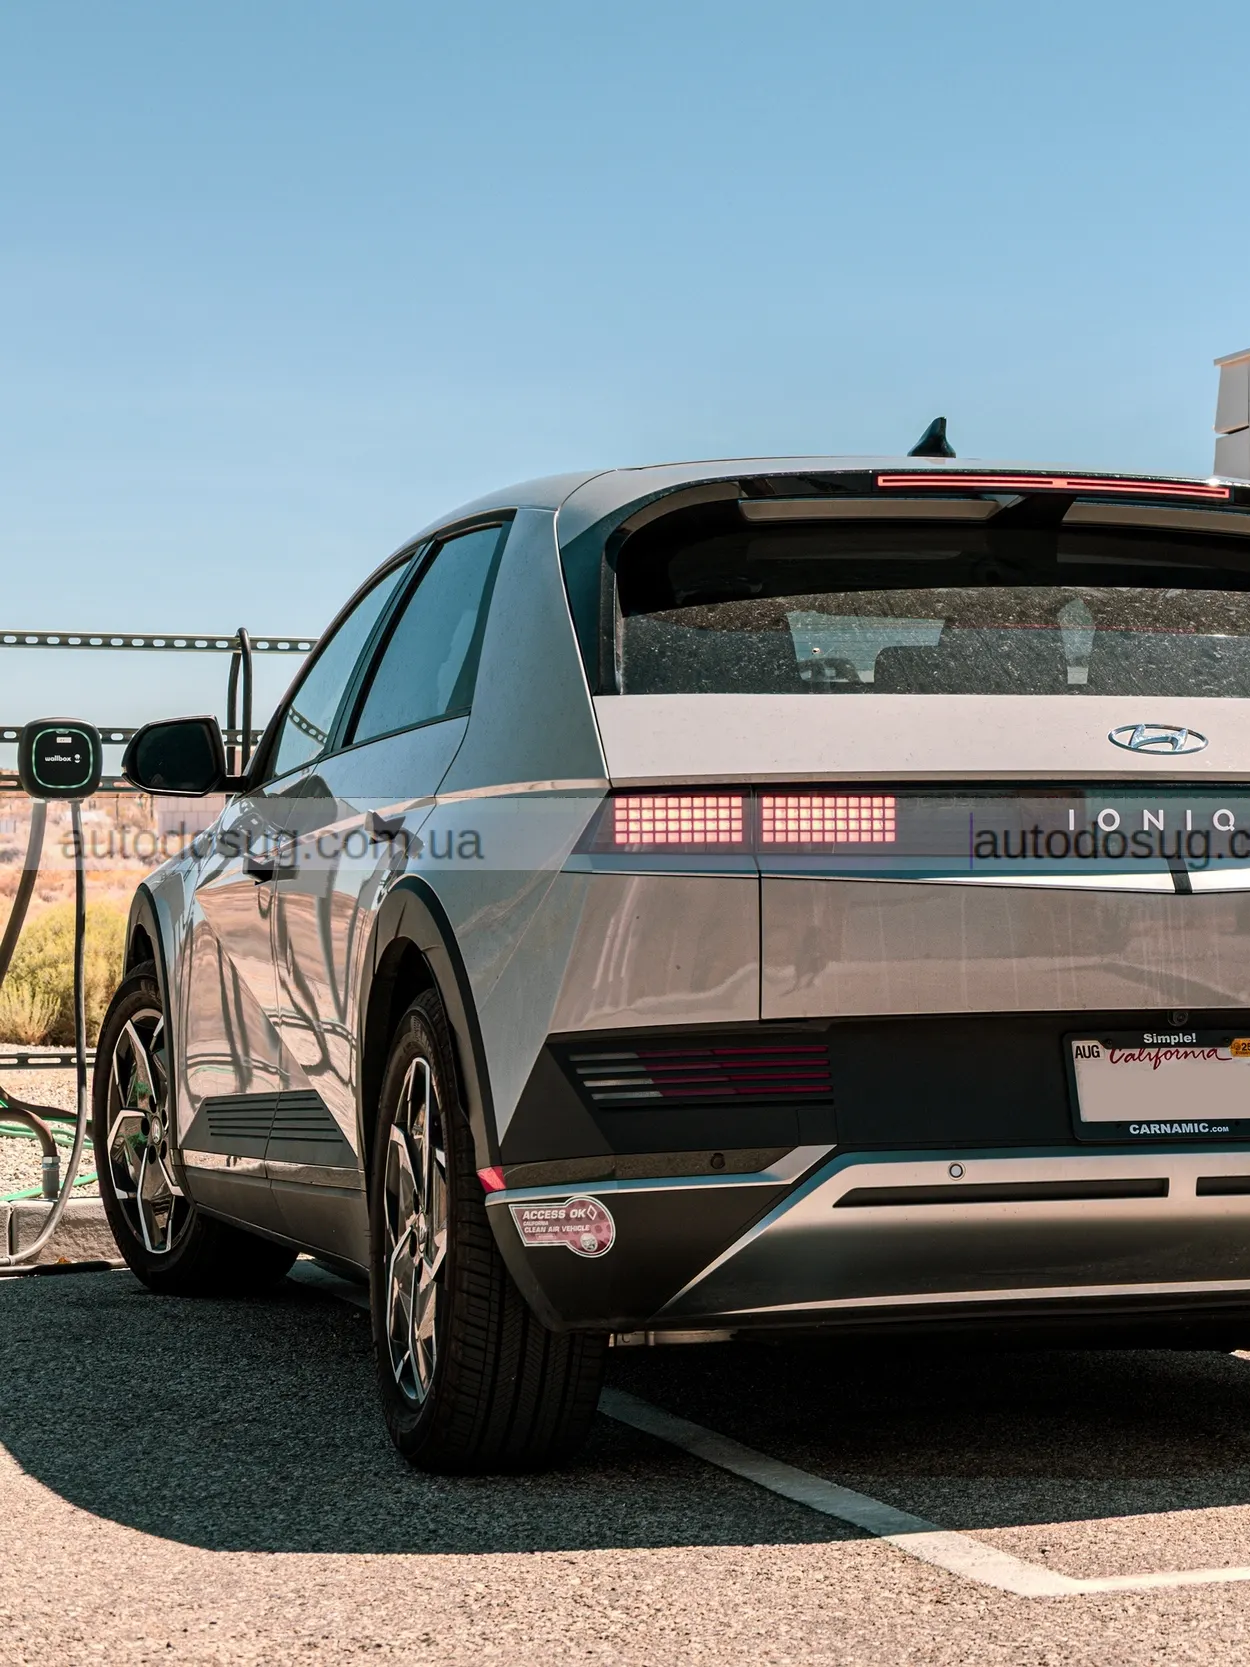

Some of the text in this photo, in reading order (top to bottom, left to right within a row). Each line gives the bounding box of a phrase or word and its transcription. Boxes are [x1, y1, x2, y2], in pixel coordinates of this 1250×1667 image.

[1068, 808, 1236, 832] IONIQ
[1143, 1033, 1197, 1046] Simple!
[1075, 1044, 1100, 1059] AUG
[1109, 1047, 1233, 1070] California
[522, 1208, 587, 1220] ACCESS OK
[548, 1225, 560, 1233] AIR
[561, 1224, 591, 1232] VEHICLE
